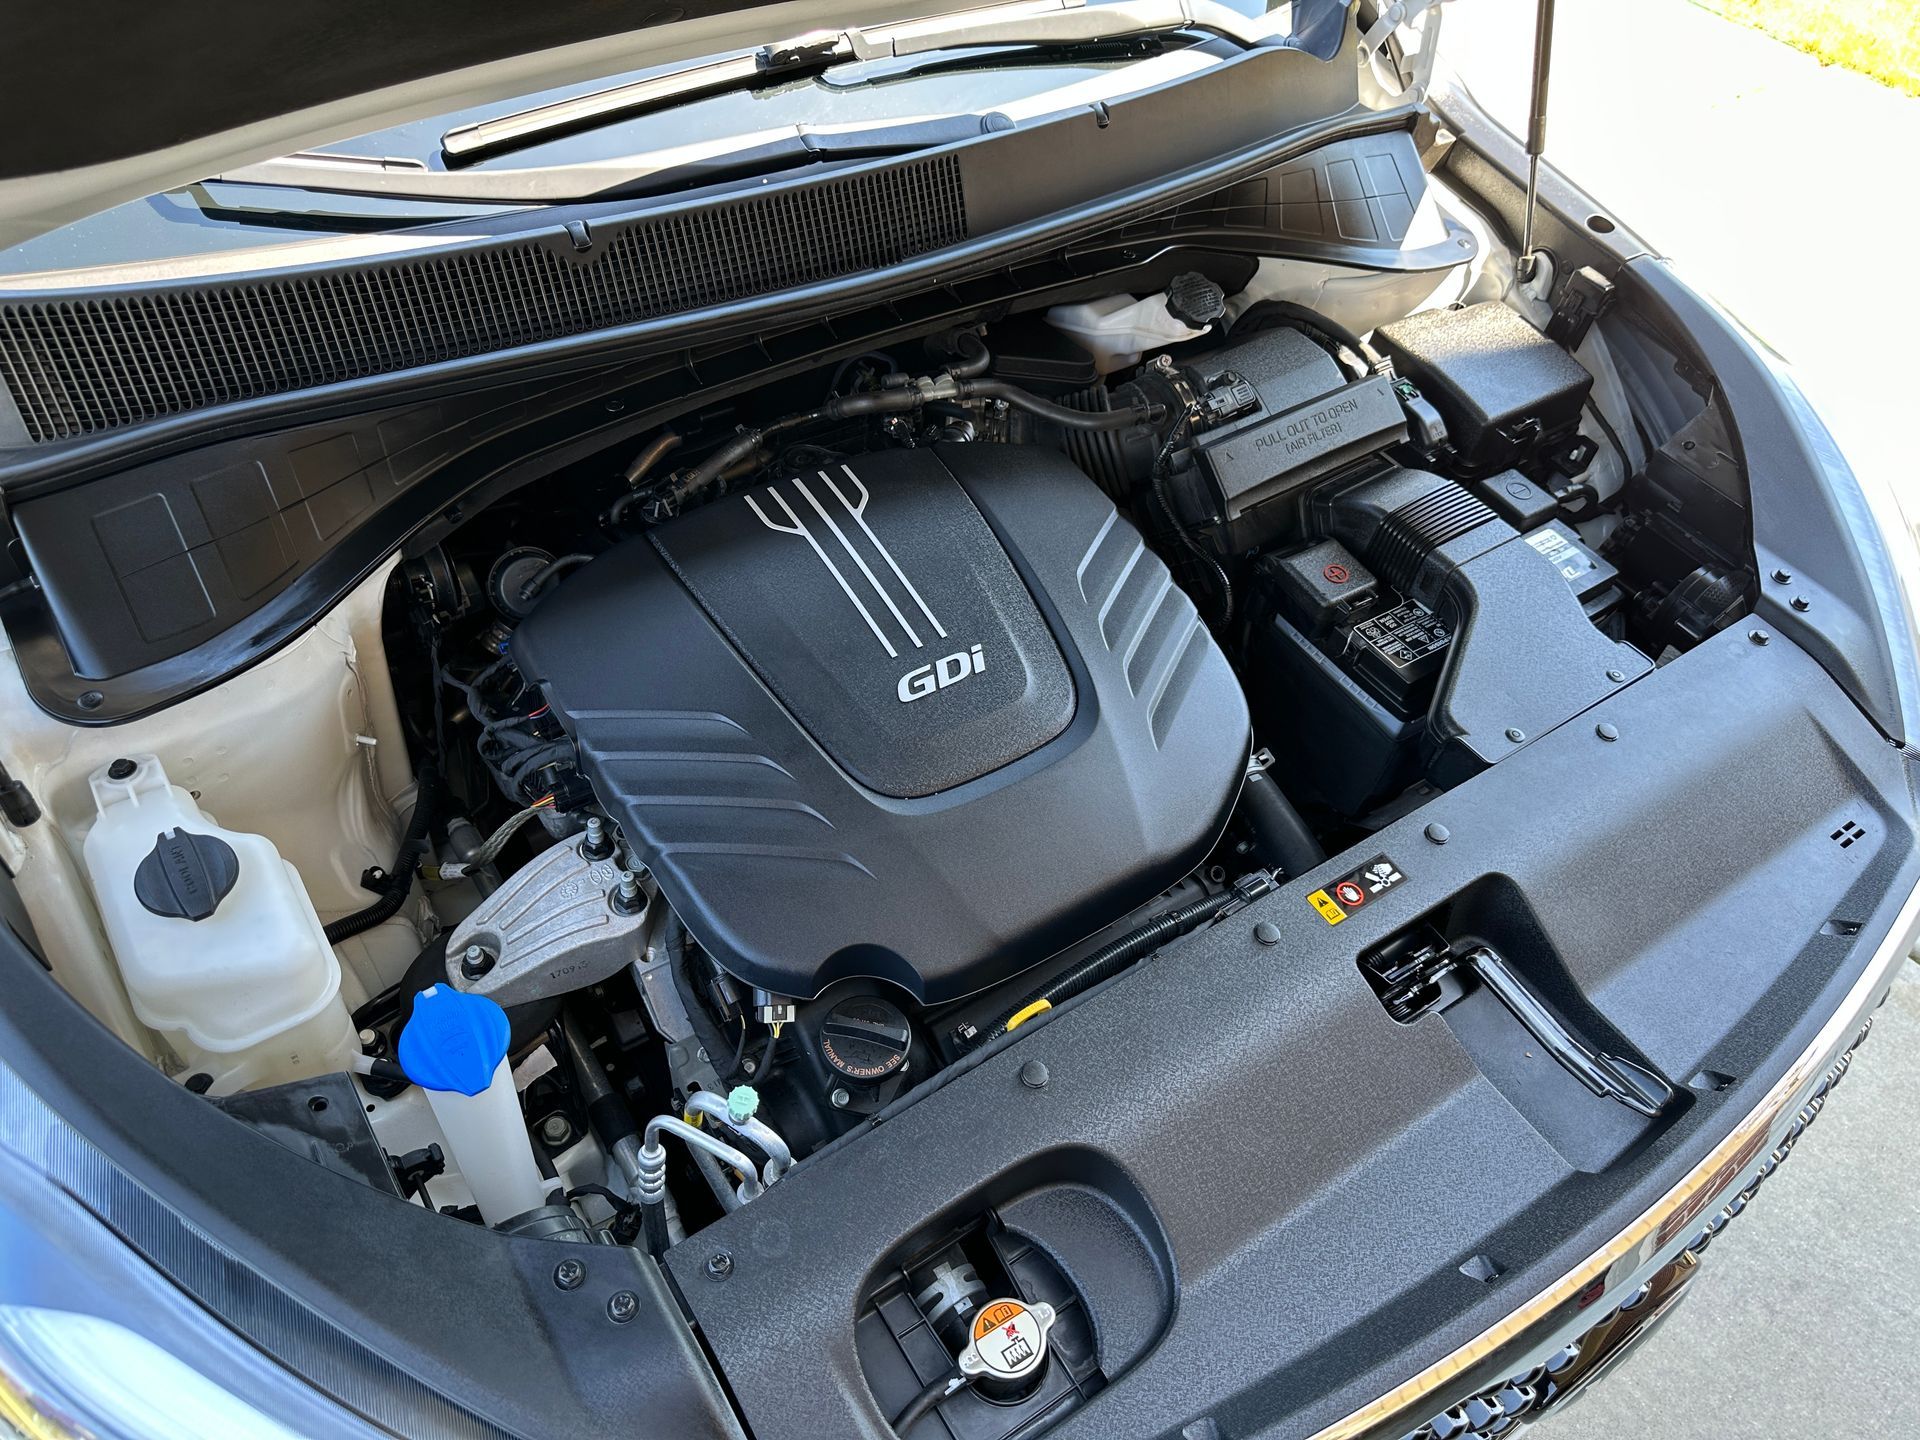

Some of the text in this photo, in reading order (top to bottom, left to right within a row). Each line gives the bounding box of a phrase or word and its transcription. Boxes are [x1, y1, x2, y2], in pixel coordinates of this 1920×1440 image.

[1255, 398, 1358, 452] PULL OUT TO OPEN
[1285, 422, 1342, 455] (AIR FILTER)
[897, 643, 986, 703] GDi
[823, 1039, 901, 1076] SEE OWNER'S MANUAL
